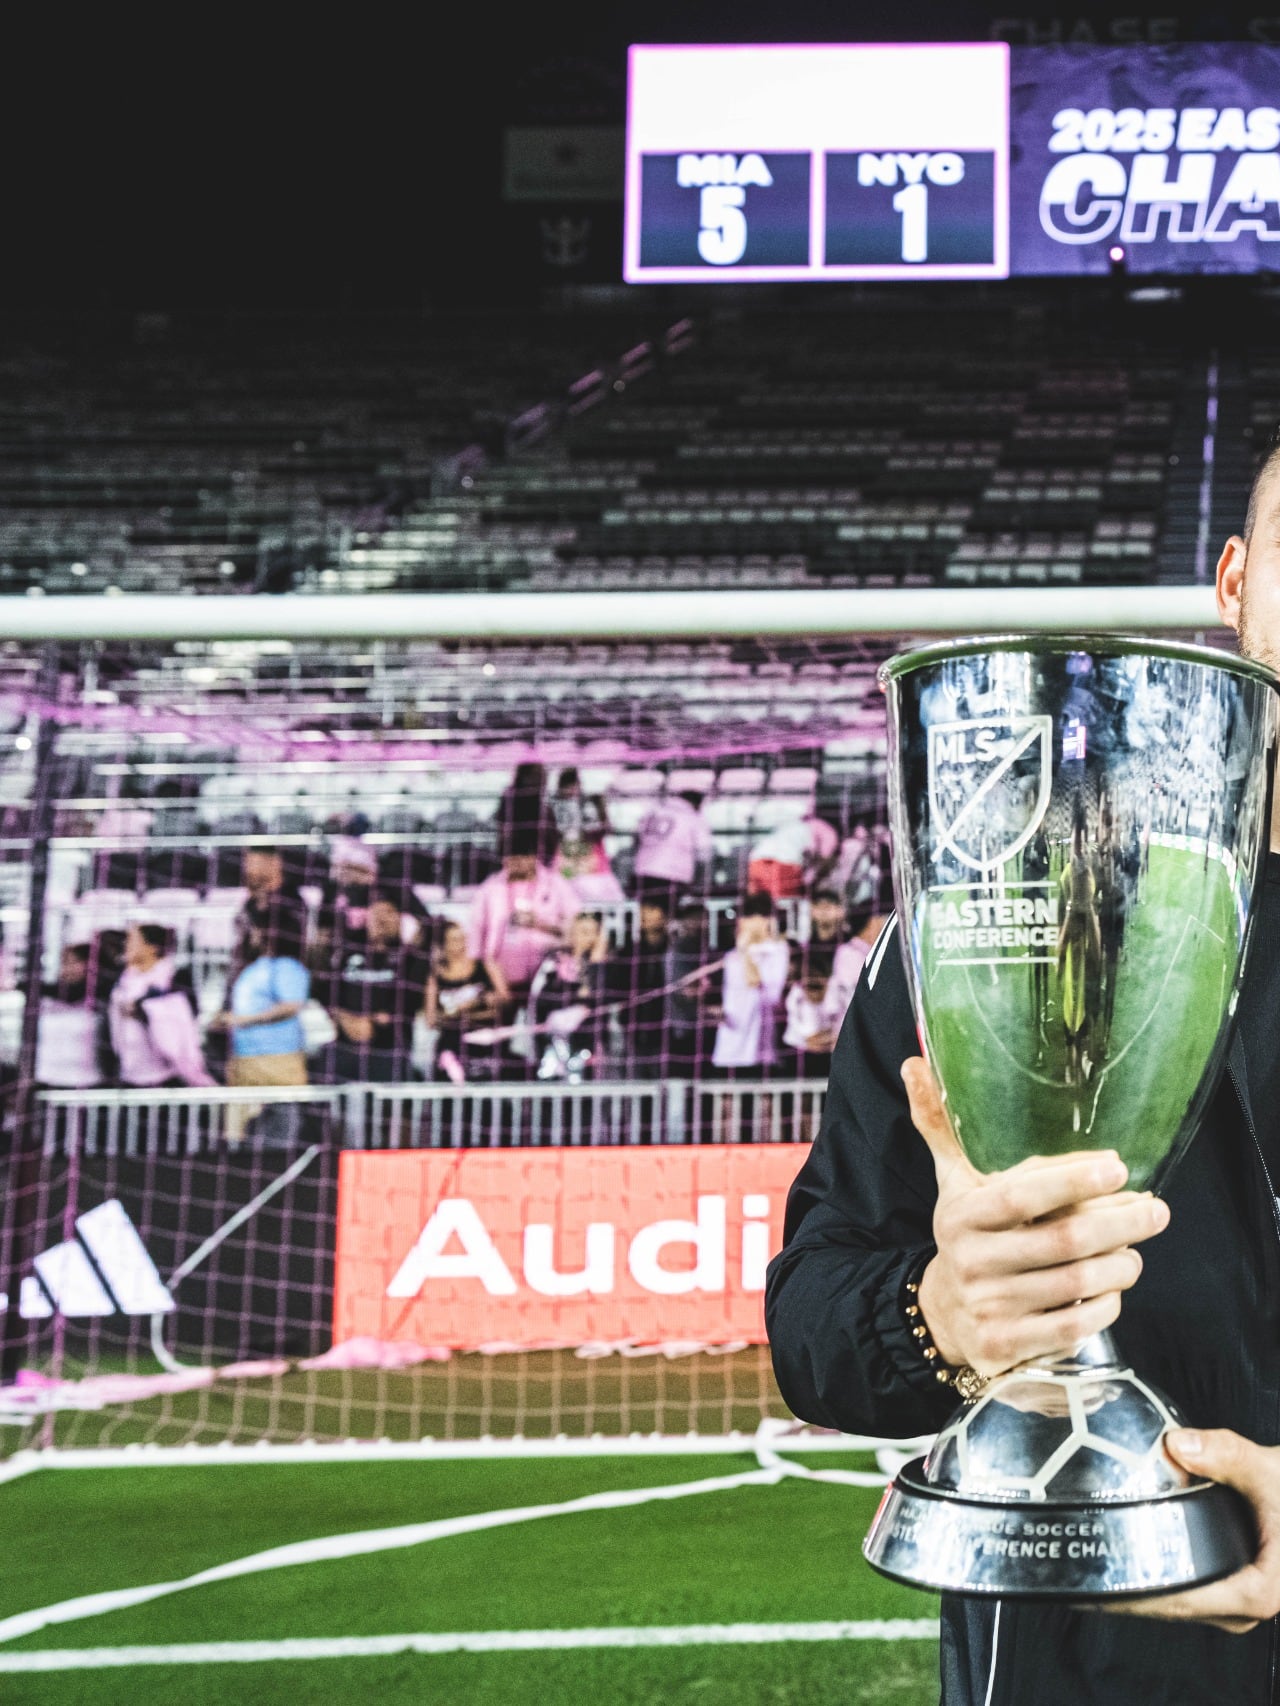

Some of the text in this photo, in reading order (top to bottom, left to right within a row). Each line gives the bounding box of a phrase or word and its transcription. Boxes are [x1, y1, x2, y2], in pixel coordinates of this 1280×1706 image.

[1048, 108, 1176, 152] 2025
[677, 153, 774, 187] MIA
[857, 152, 966, 186] NYC
[697, 184, 748, 265] 5
[893, 182, 928, 263] 1
[935, 729, 996, 766] MLS
[929, 898, 1058, 929] EASTERN
[933, 926, 1060, 949] CONFERENCE
[386, 1194, 770, 1297] Audi
[1023, 1521, 1105, 1537] SOCCER
